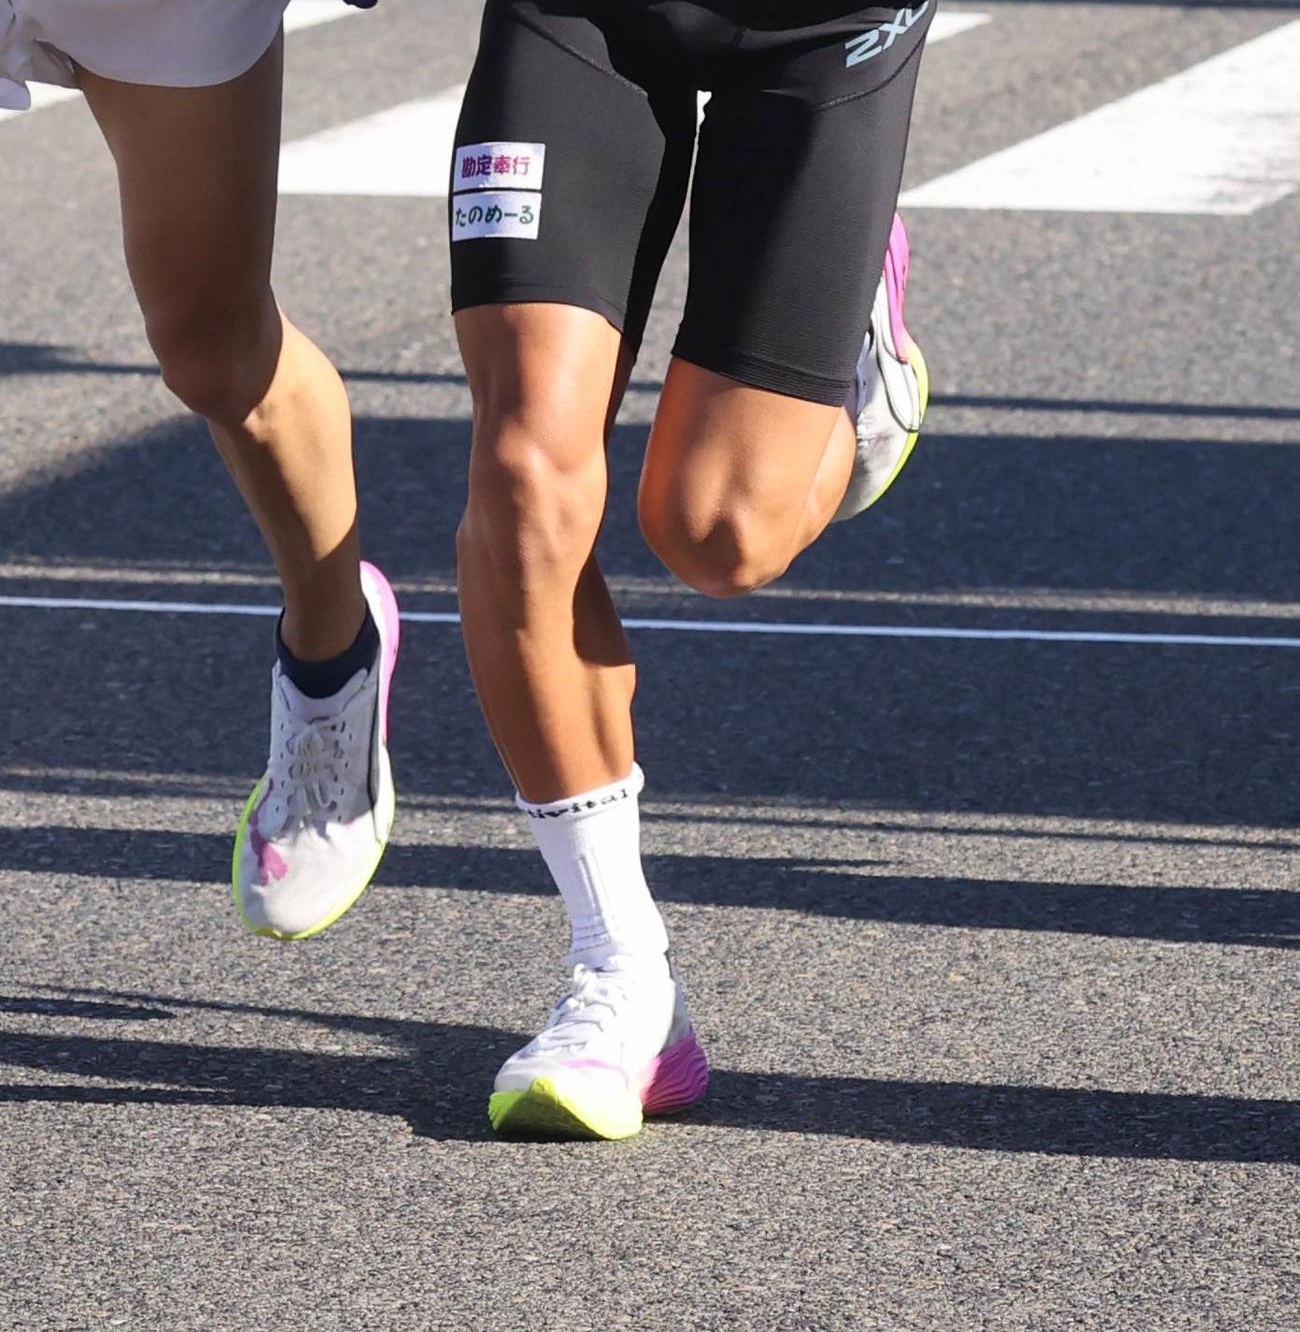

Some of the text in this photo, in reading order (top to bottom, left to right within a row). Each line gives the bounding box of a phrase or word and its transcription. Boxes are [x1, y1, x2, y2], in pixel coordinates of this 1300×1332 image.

[461, 154, 531, 179] 勘定奉行
[455, 204, 534, 228] たのめーる
